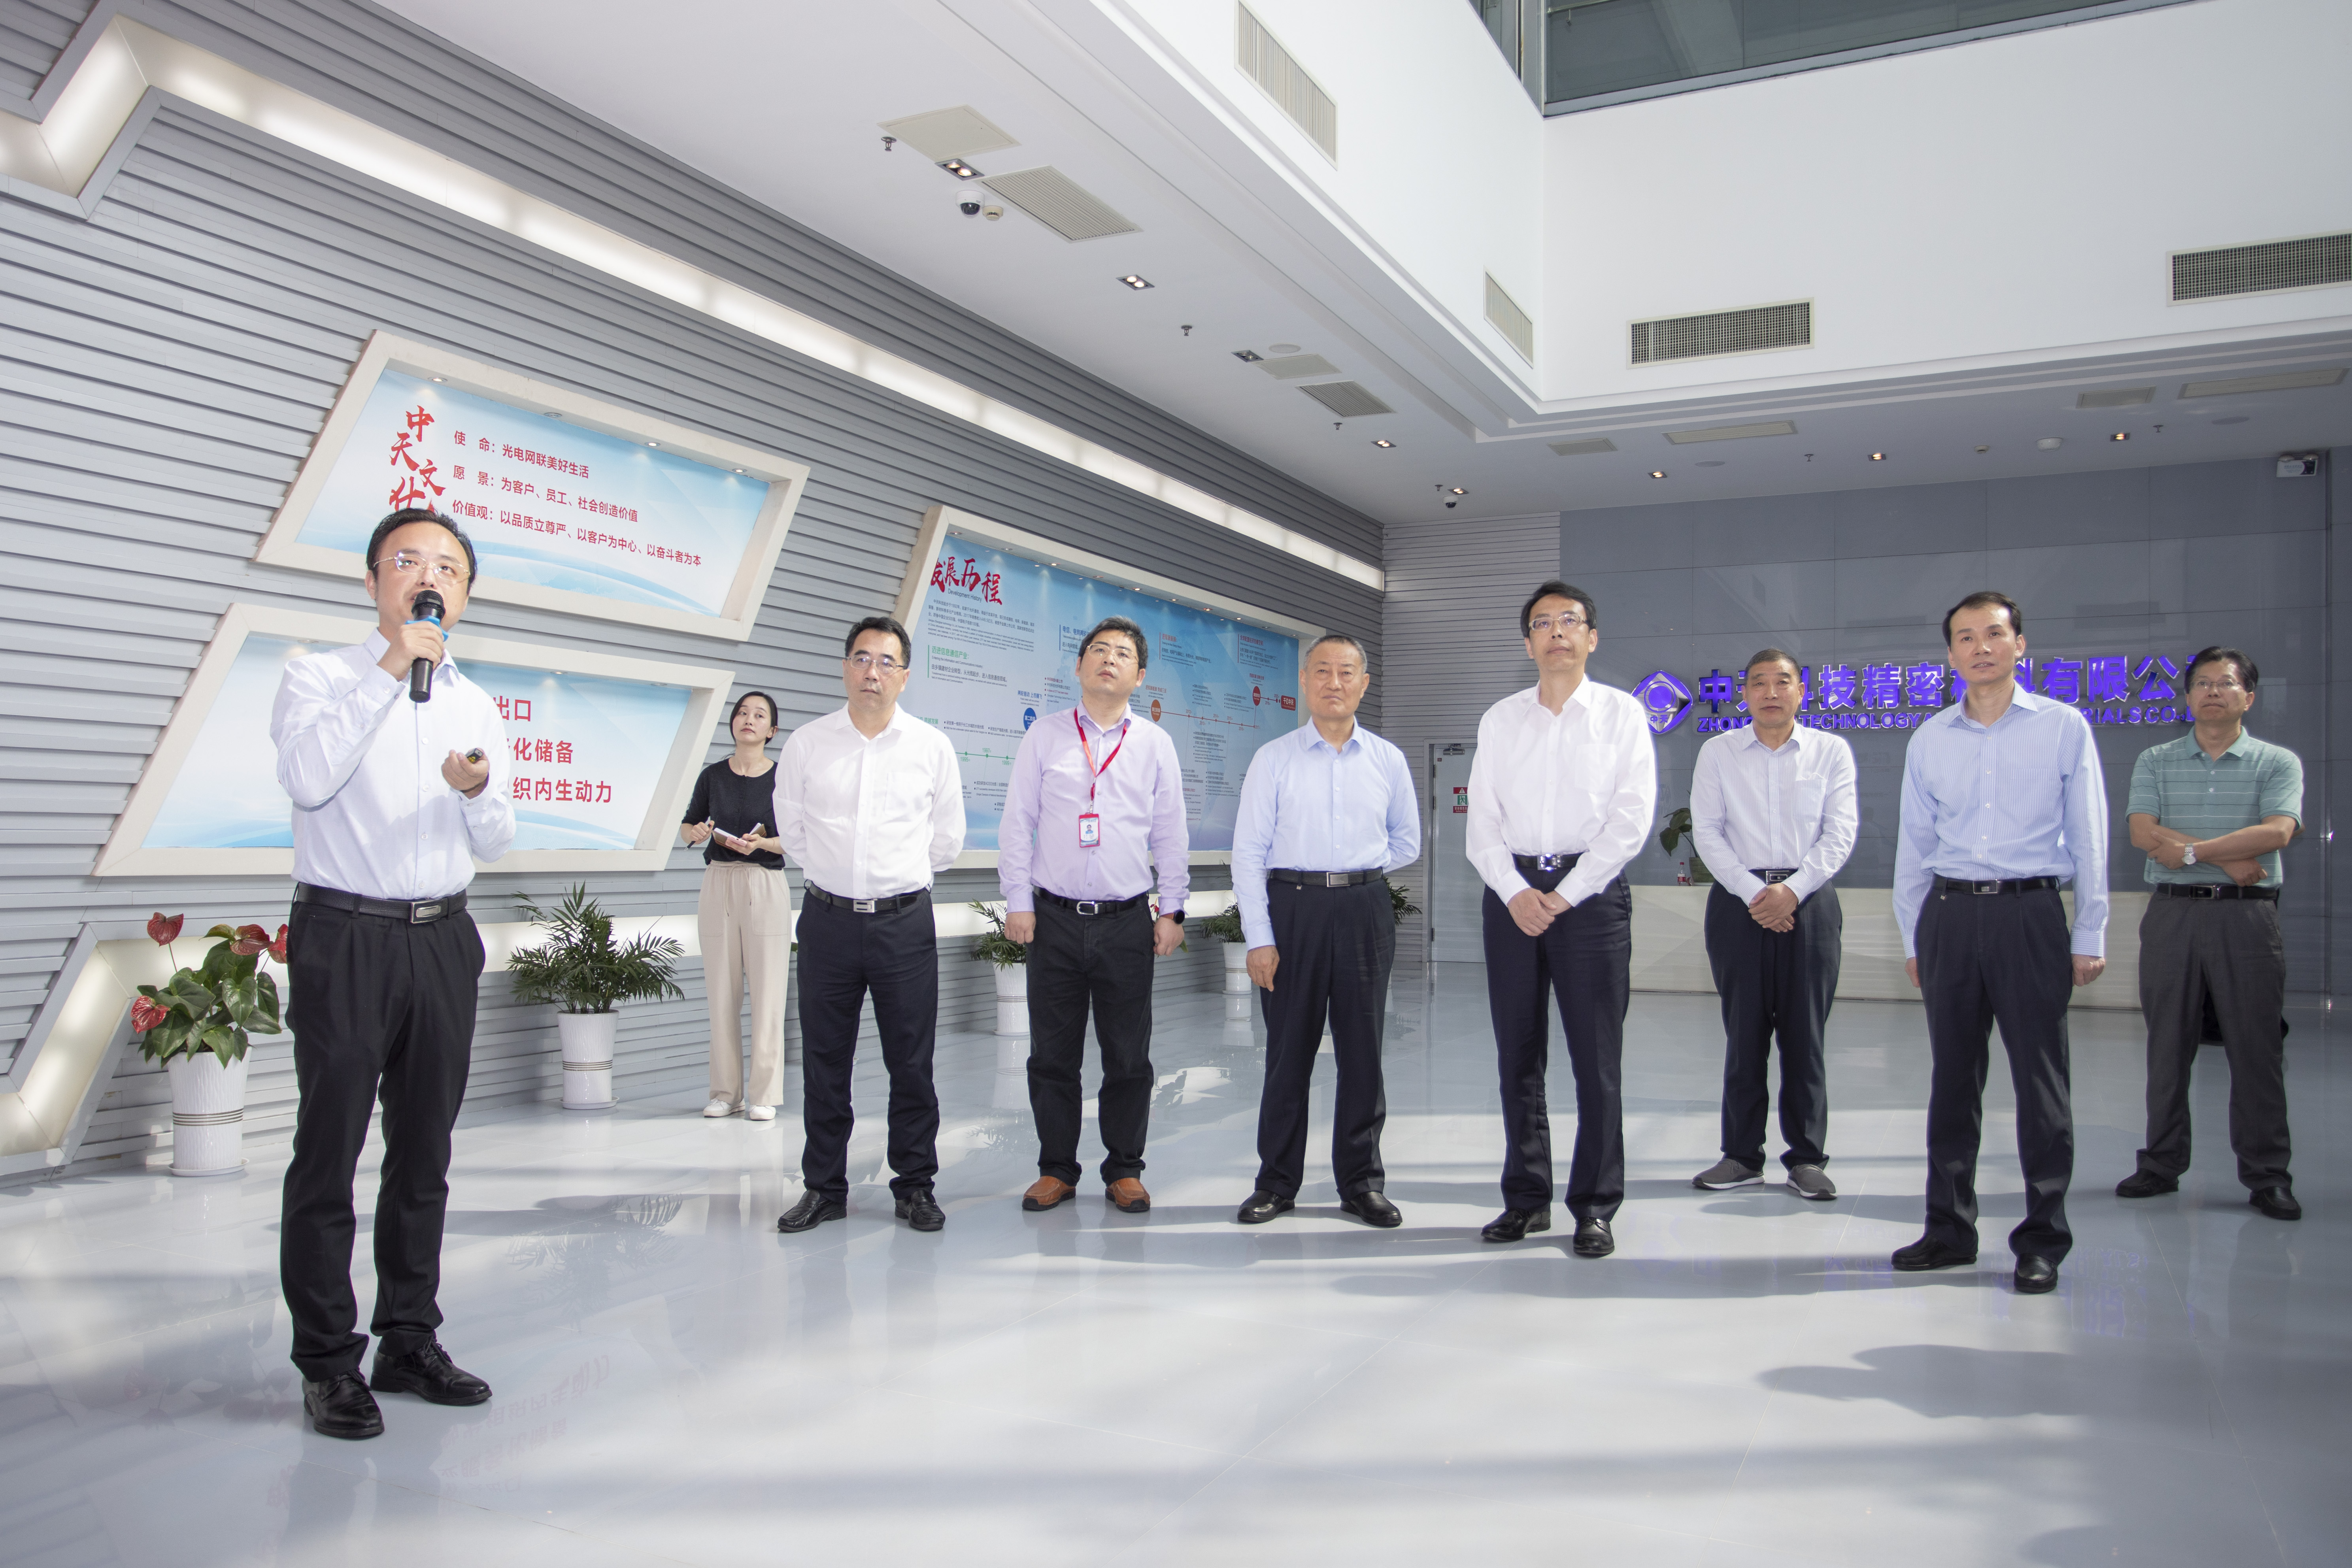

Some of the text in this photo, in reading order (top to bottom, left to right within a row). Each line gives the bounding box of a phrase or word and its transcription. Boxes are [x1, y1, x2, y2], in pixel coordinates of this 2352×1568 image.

[930, 556, 1002, 606] 发展历程
[948, 589, 982, 603] Development History
[1063, 626, 1089, 637] 电信、电网两轮
[1650, 715, 1668, 724] 中天
[1799, 712, 1922, 730] TECHNOLOGY
[2080, 708, 2141, 723] RIALS
[507, 737, 573, 764] 化储备
[508, 777, 611, 803] 织内生动力
